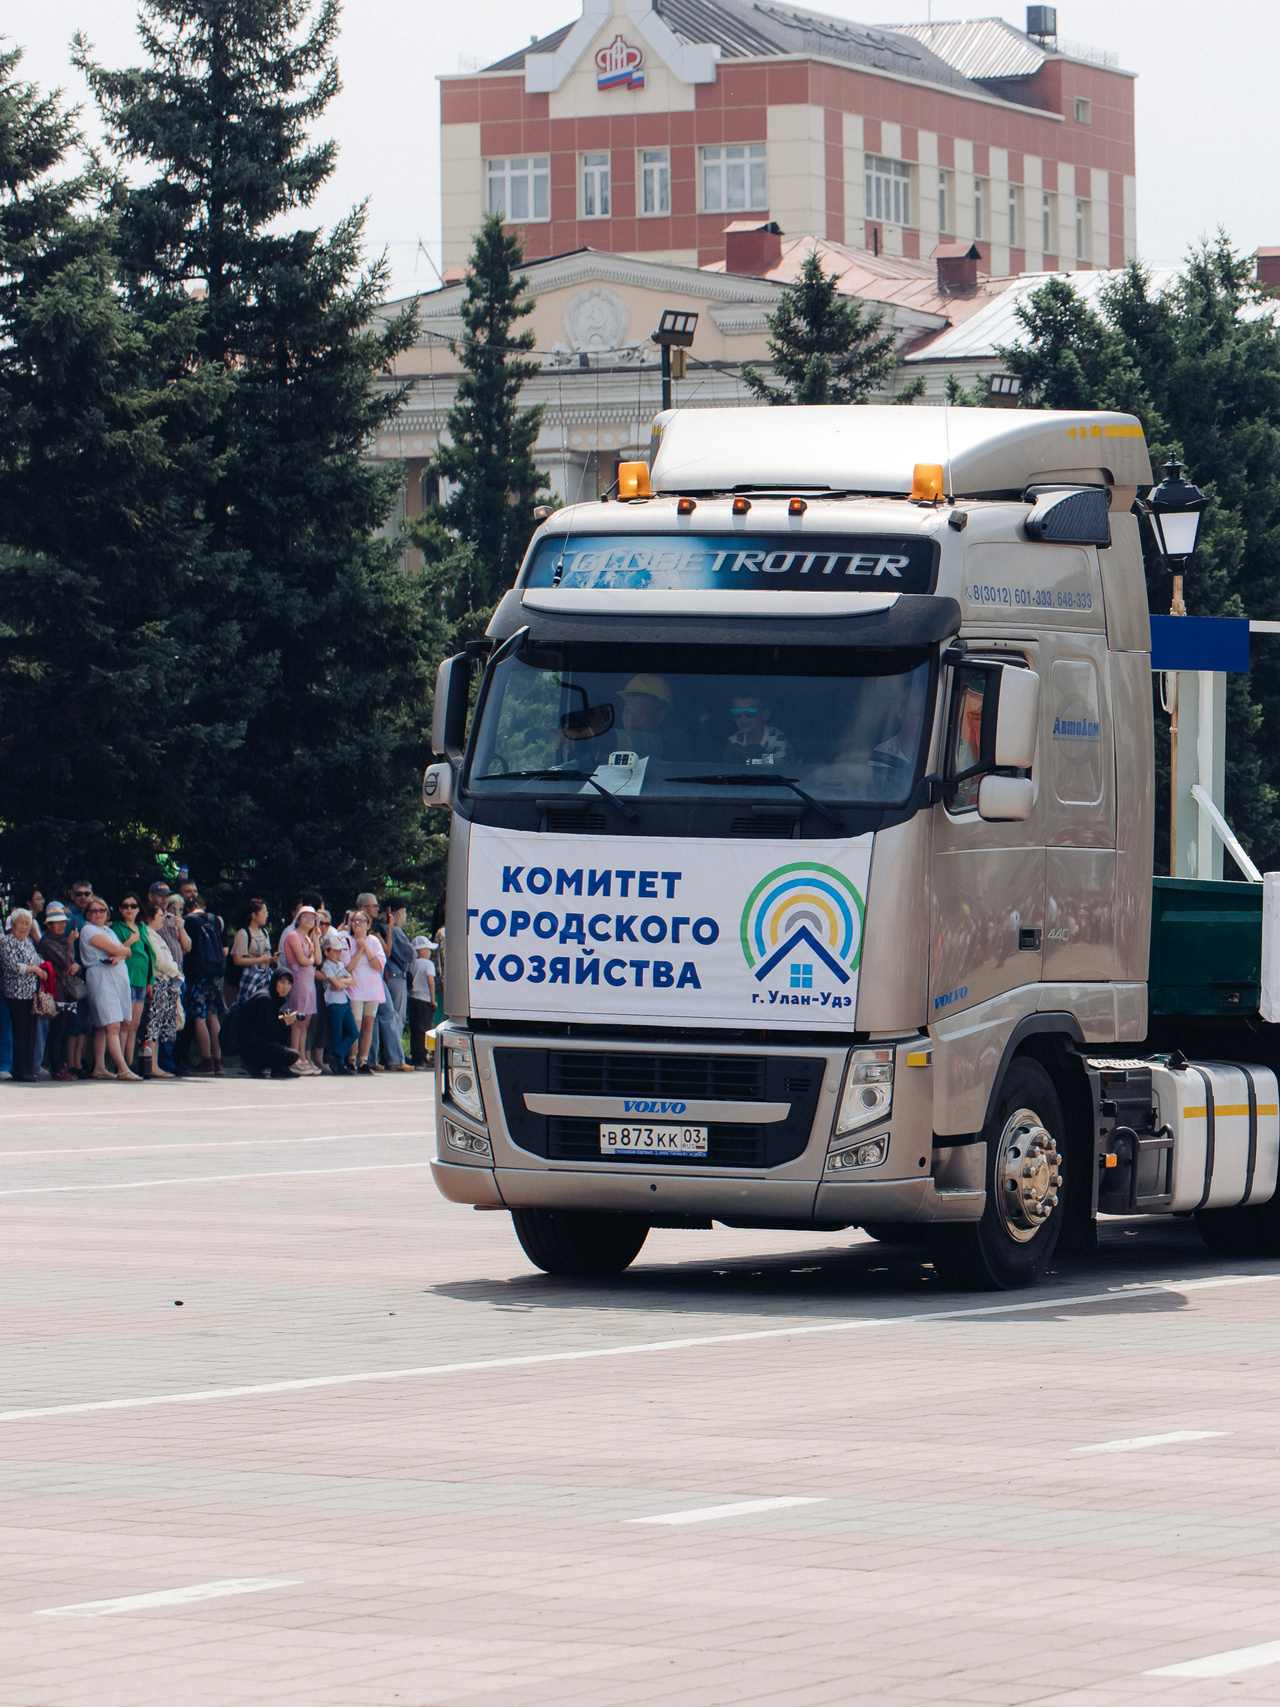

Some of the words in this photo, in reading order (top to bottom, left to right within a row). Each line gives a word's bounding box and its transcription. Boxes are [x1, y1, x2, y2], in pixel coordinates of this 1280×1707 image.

[571, 550, 910, 578] GLOBETROTTER
[973, 585, 1012, 607] 8(3012)
[1057, 591, 1093, 609] 648-333
[501, 865, 683, 899] КОМИТЕТ
[466, 908, 720, 945] ГОРОДСКОГО
[475, 949, 702, 989] ХОЗЯЙСТВА
[752, 993, 765, 1004] г.
[768, 990, 852, 1008] Улан-Удэ
[934, 986, 969, 1010] VOLVO
[623, 1100, 686, 1115] VOLVO
[684, 1129, 701, 1143] 03
